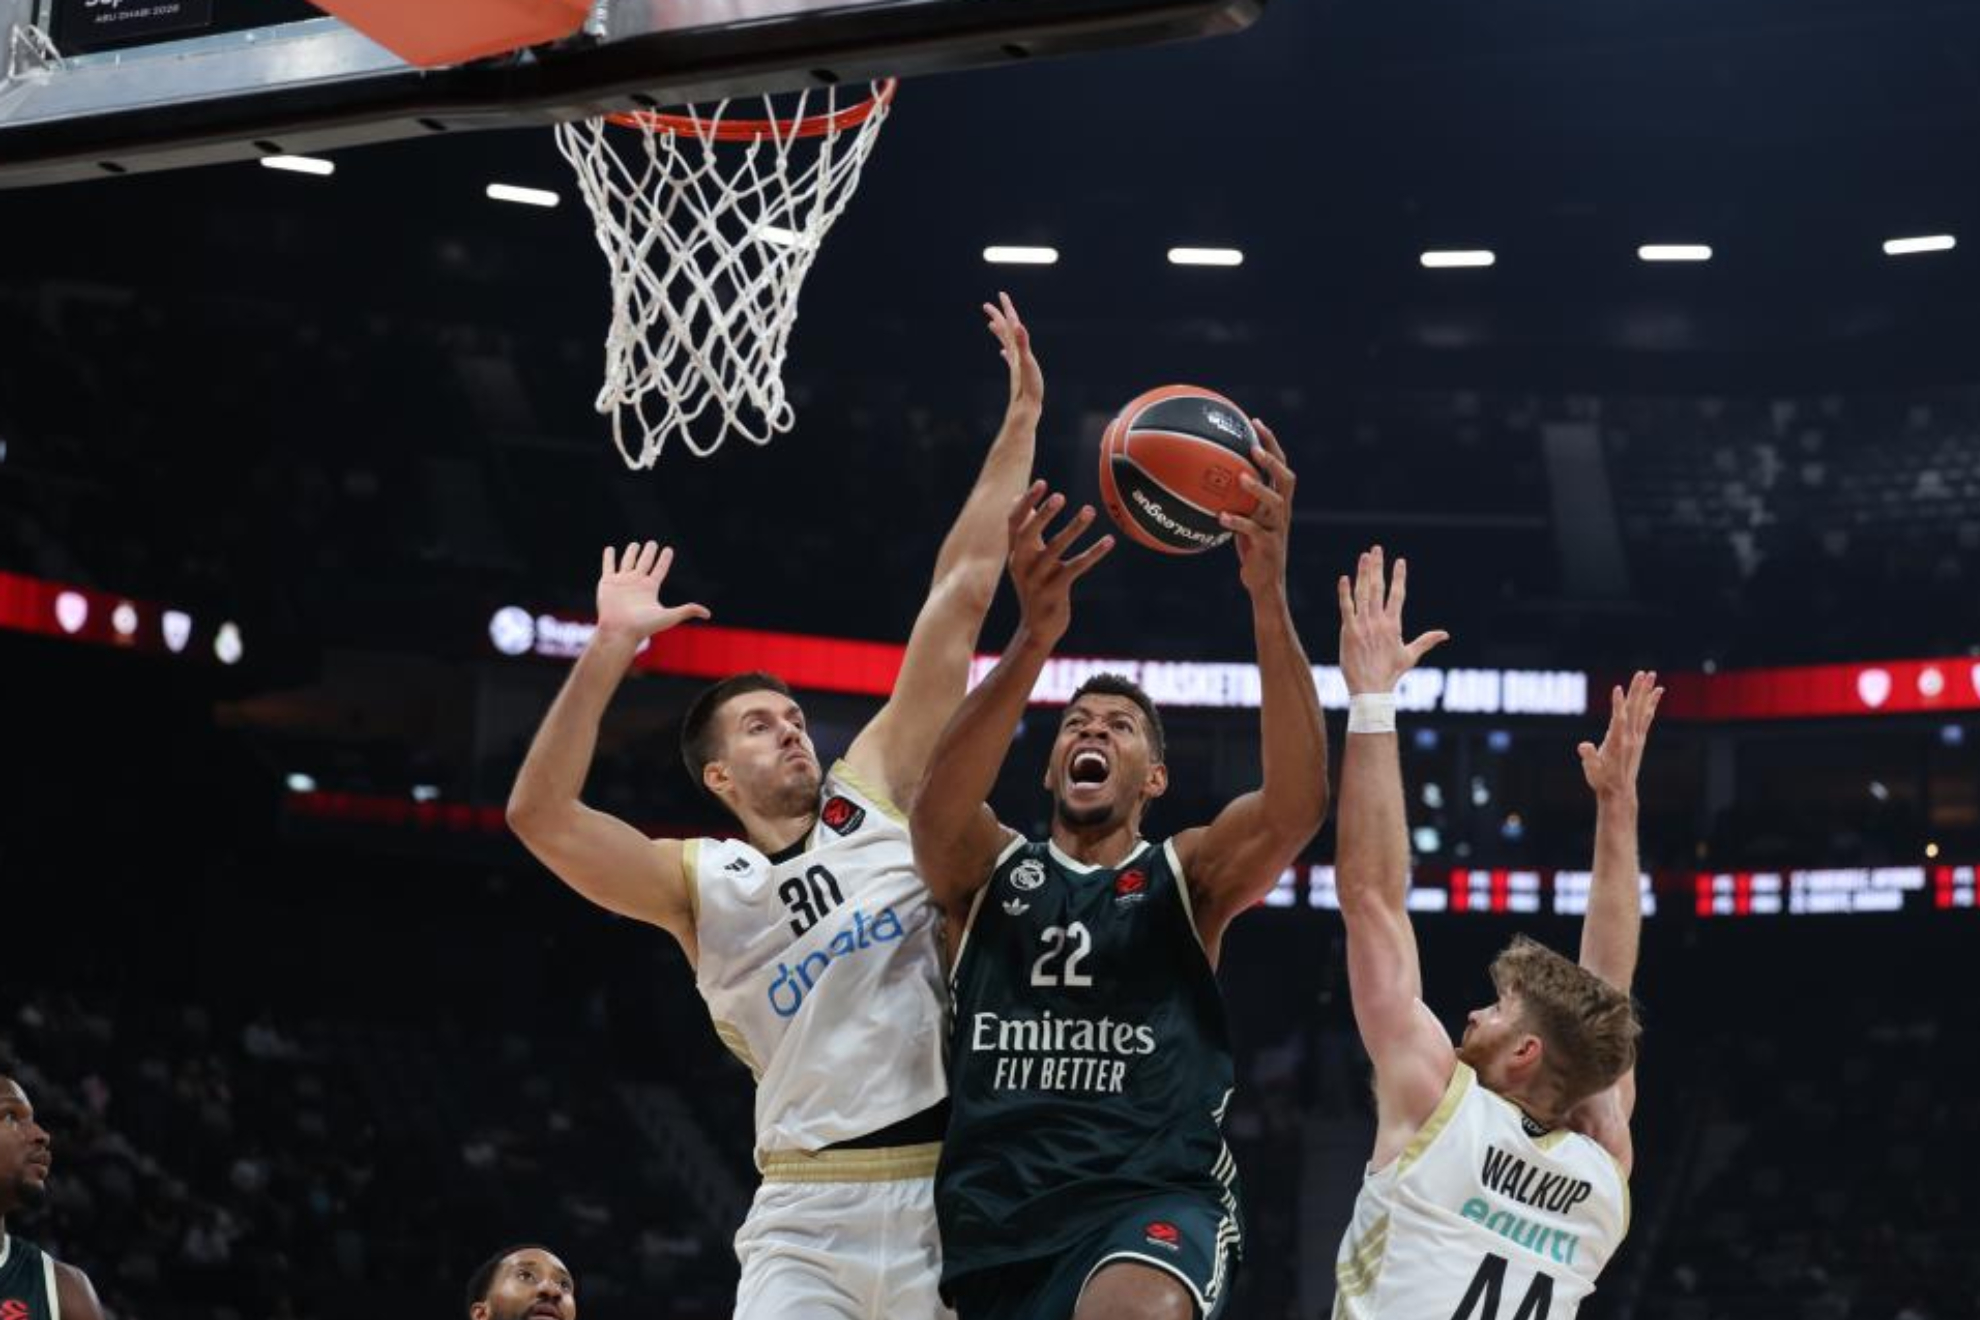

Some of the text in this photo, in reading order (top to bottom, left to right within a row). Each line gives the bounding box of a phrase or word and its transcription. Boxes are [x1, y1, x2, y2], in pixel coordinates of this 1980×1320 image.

[777, 864, 845, 938] 30
[767, 907, 905, 1018] dnata
[1030, 920, 1093, 987] 22
[971, 1009, 1157, 1055] Emirates
[993, 1056, 1127, 1093] FLY BETTER
[1481, 1145, 1593, 1215] WALKUP
